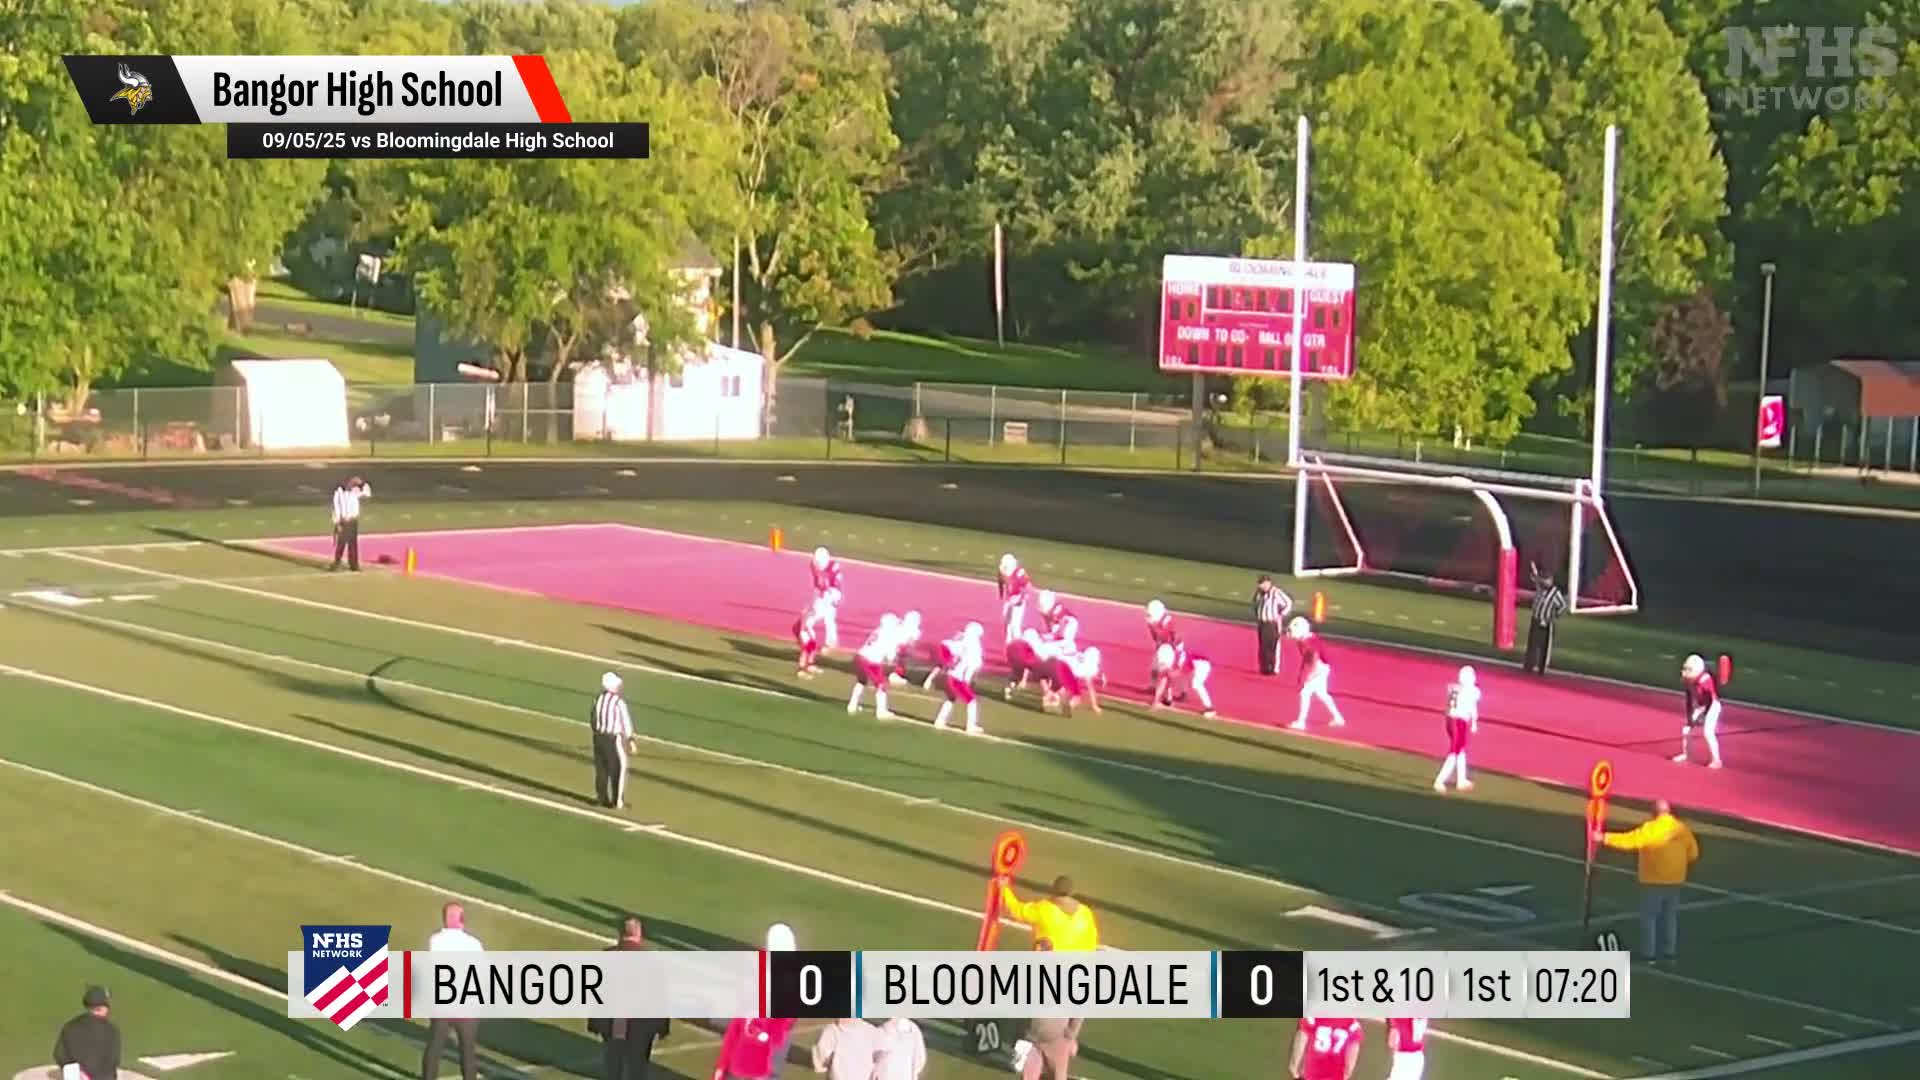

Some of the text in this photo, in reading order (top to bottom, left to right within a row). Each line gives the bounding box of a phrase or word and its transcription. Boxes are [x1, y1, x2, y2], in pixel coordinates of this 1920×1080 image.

[1178, 326, 1209, 341] DOWN
[1216, 328, 1229, 343] TO
[1303, 334, 1326, 347] QTR
[975, 1021, 1000, 1052] 20
